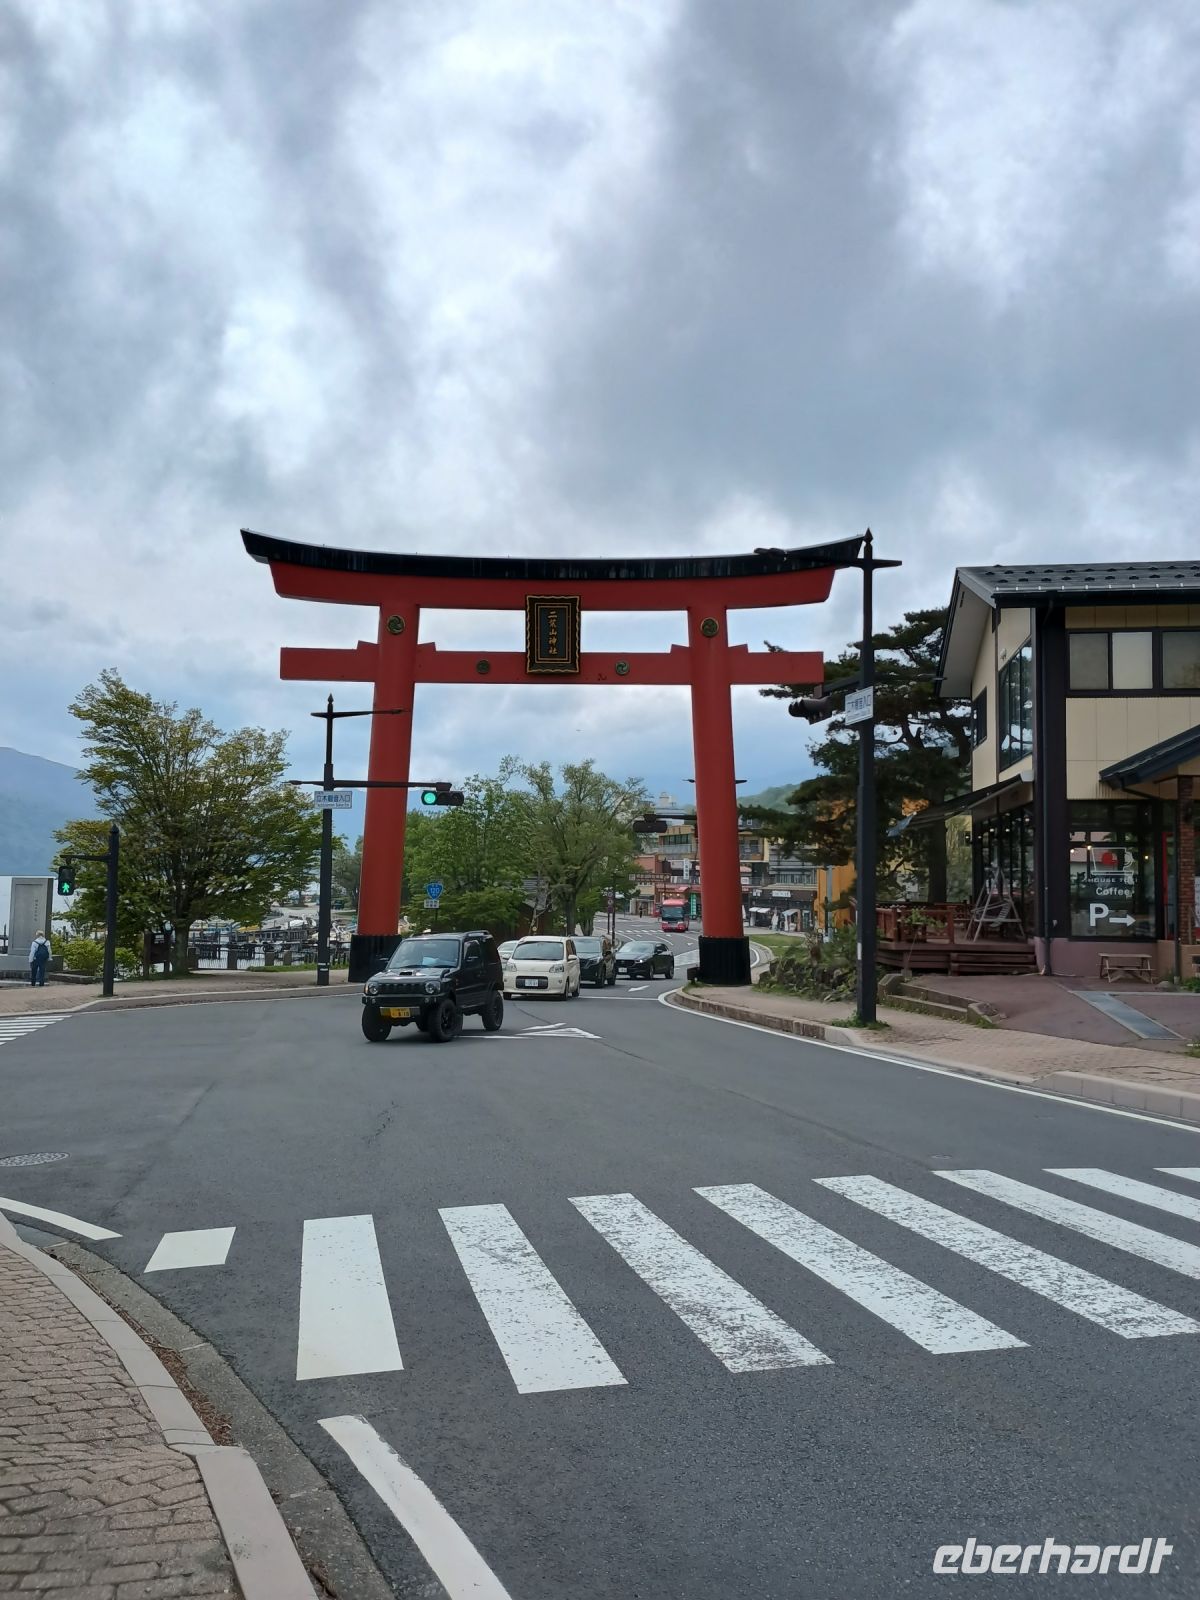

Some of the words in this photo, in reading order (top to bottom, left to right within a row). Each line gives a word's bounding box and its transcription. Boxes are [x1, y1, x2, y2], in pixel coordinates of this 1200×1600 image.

[547, 610, 558, 655] 二荒山神社
[1095, 886, 1130, 896] Coffee
[1089, 903, 1109, 927] P
